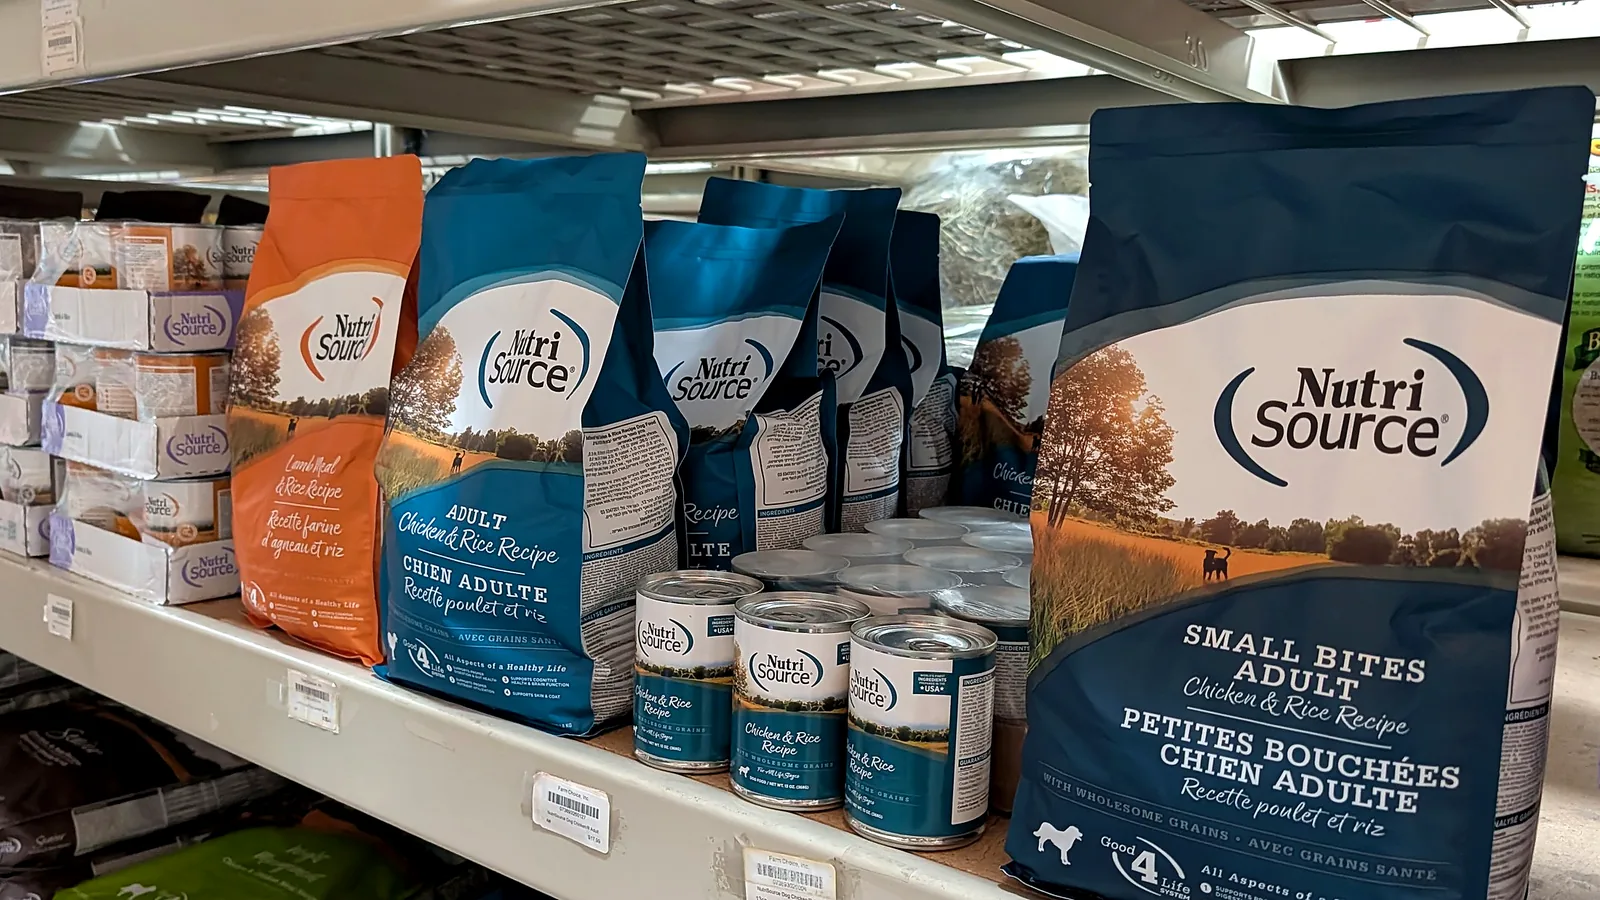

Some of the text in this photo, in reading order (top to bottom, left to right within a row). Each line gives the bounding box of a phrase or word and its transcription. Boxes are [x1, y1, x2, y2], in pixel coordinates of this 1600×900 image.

[227, 252, 253, 263] Sourc
[172, 321, 217, 337] Source
[180, 313, 211, 326] Nutri
[334, 313, 376, 338] Nutri
[316, 334, 369, 361] Sourc
[507, 329, 562, 361] Nutri
[488, 352, 570, 393] Source
[695, 354, 752, 380] Nutri
[672, 377, 752, 401] Source
[1292, 367, 1425, 411] Nutri
[184, 433, 216, 446] Nutri
[1251, 400, 1440, 458] Source
[175, 442, 221, 456] Source
[285, 454, 313, 473] Lamb
[283, 476, 306, 496] Rice
[306, 480, 343, 504] Recipe
[445, 504, 508, 530] ADULT
[684, 503, 740, 527] Recipe
[993, 497, 1030, 516] CHIE
[267, 509, 343, 539] Recette farine
[309, 540, 326, 558] et
[324, 543, 345, 558] riz
[398, 511, 560, 569] Chicken & Rice Recipe
[690, 543, 731, 557] LTE
[190, 561, 234, 580] Source
[199, 553, 229, 566] Nutri
[403, 555, 453, 585] CHIEN
[458, 574, 548, 603] ADULTE
[344, 601, 360, 609] Life
[404, 577, 548, 624] Recette poulet et riz
[458, 633, 485, 642] AVEC
[488, 635, 528, 644] GRAINS
[642, 630, 682, 653] Source
[647, 622, 676, 640] Nutri
[403, 638, 418, 651] Good
[1183, 624, 1426, 683] SMALL BITES
[416, 647, 430, 670] 4
[444, 653, 455, 662] All
[456, 656, 485, 669] Aspects
[487, 662, 497, 670] of
[506, 663, 544, 673] Healthy
[546, 664, 567, 673] Life
[766, 654, 804, 672] Nutri
[757, 663, 811, 686] Source
[855, 669, 879, 693] Nutri
[1233, 660, 1359, 702] ADULT
[635, 685, 693, 709] Chicken & Rice
[1183, 676, 1411, 740] Chicken & Rice Recipe
[643, 701, 671, 719] Recipe
[745, 722, 821, 745] Chicken & Rice
[761, 740, 798, 758] Recipe
[1120, 707, 1254, 756] PETITES
[1263, 738, 1461, 790] BOUCHÉES
[751, 754, 799, 768] WHOLESOME
[849, 757, 874, 780] Recipe
[861, 752, 896, 772] & Rice
[557, 785, 568, 793] Farm
[1160, 743, 1419, 814] CHIEN ADULTE
[1180, 777, 1386, 838] Recette poulet et riz
[1043, 772, 1437, 881] WITH WHOLESOME GRAINS AVEC GRAINS SANTÉ
[1100, 836, 1136, 856] Good
[1131, 850, 1159, 885] 4
[756, 886, 781, 896] NutriSource
[1159, 887, 1191, 900] SYSTEM
[1160, 877, 1191, 895] Life
[1201, 865, 1313, 900] All Aspects of
